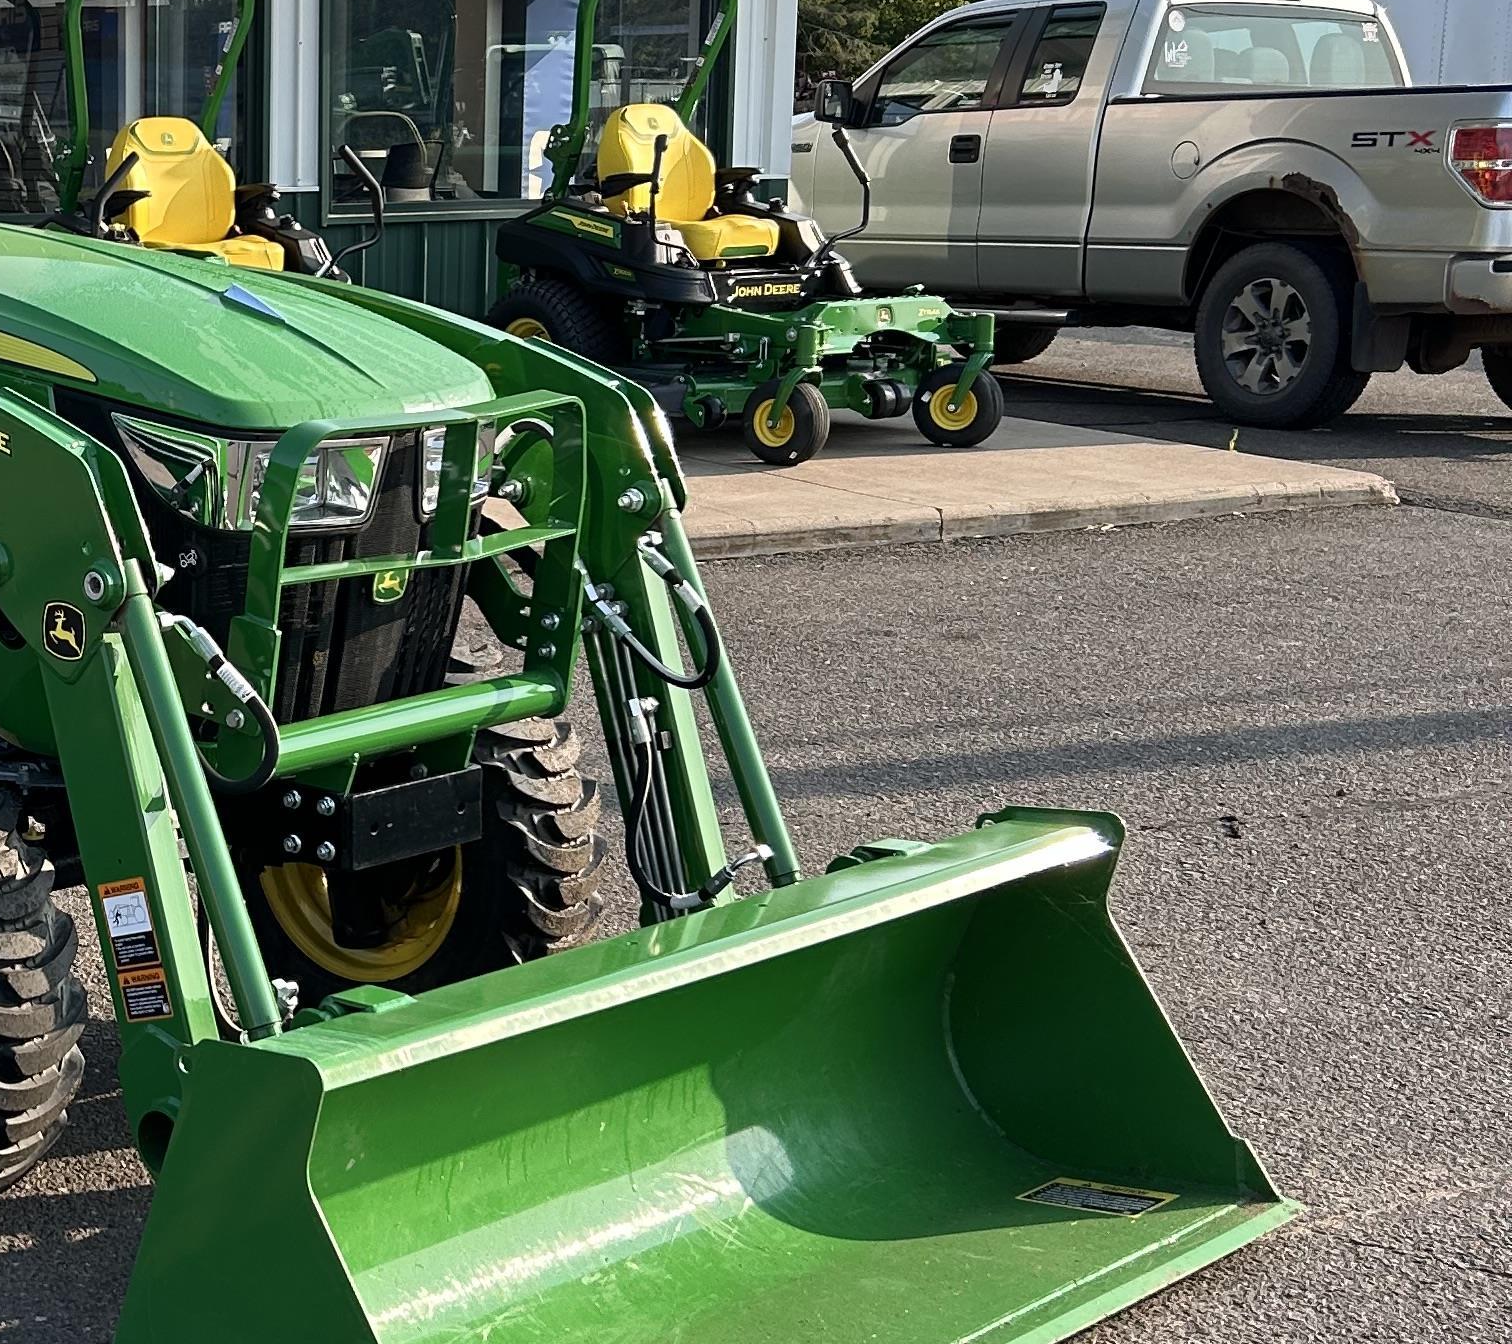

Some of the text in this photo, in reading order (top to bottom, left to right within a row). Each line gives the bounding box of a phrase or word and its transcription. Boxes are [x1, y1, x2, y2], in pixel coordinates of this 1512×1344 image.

[1351, 130, 1437, 147] STX
[733, 283, 801, 298] JOHN DEERE
